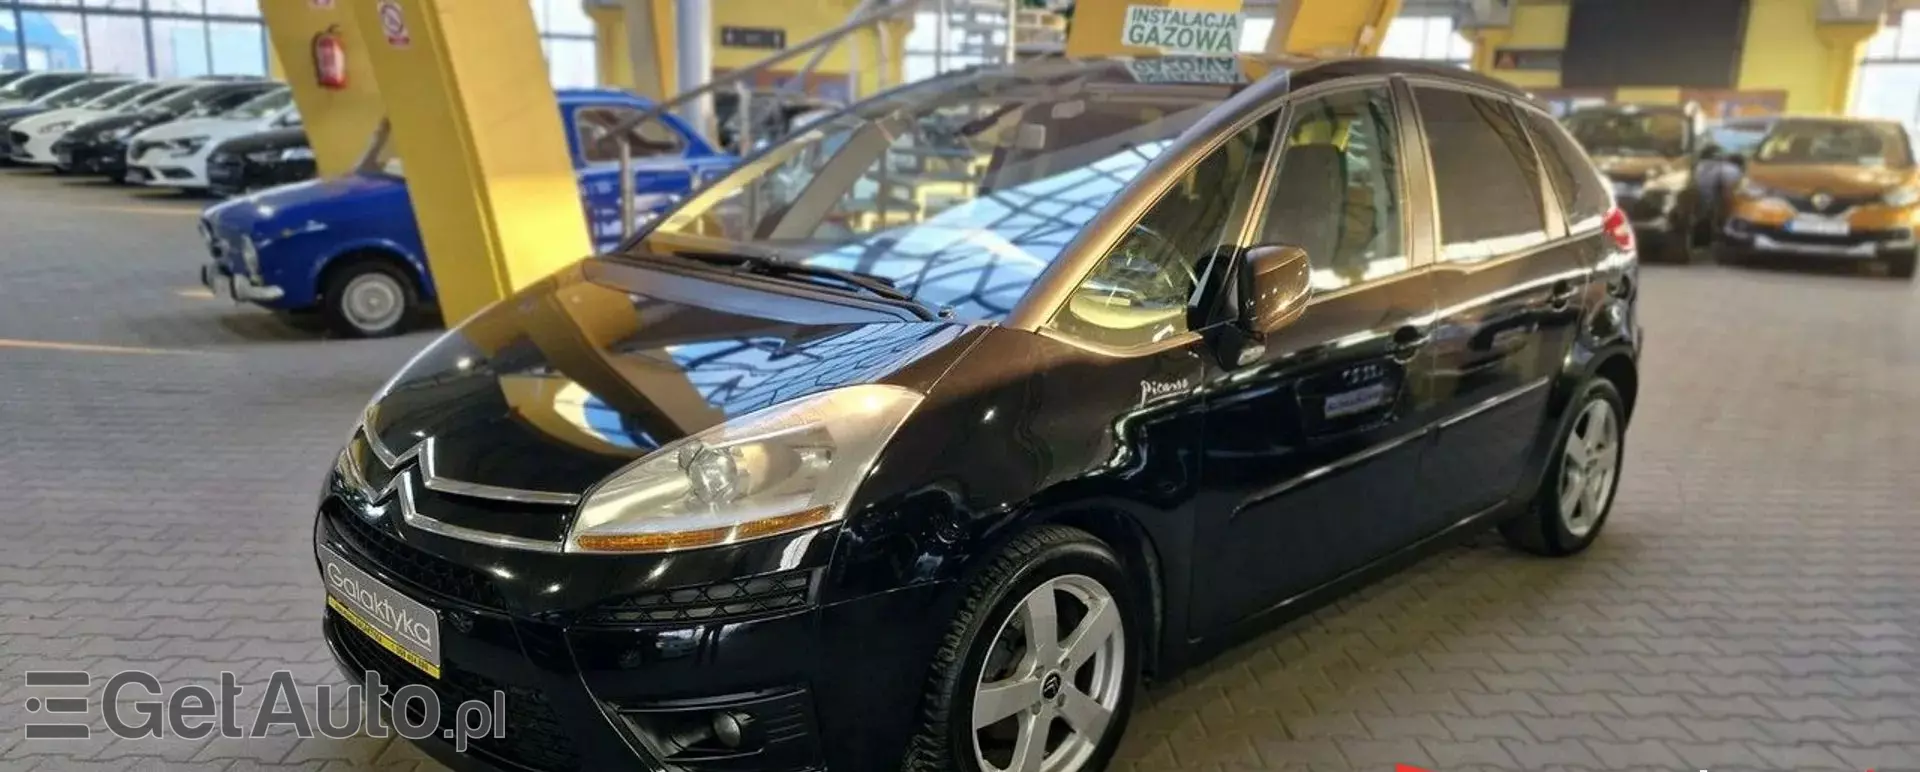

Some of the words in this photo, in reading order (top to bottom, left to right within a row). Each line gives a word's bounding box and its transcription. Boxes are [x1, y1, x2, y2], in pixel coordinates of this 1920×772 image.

[1131, 7, 1238, 29] INSTALACJA
[1128, 24, 1233, 52] GAZOWA
[1140, 378, 1189, 407] Picasso
[327, 562, 432, 647] Galaktyka
